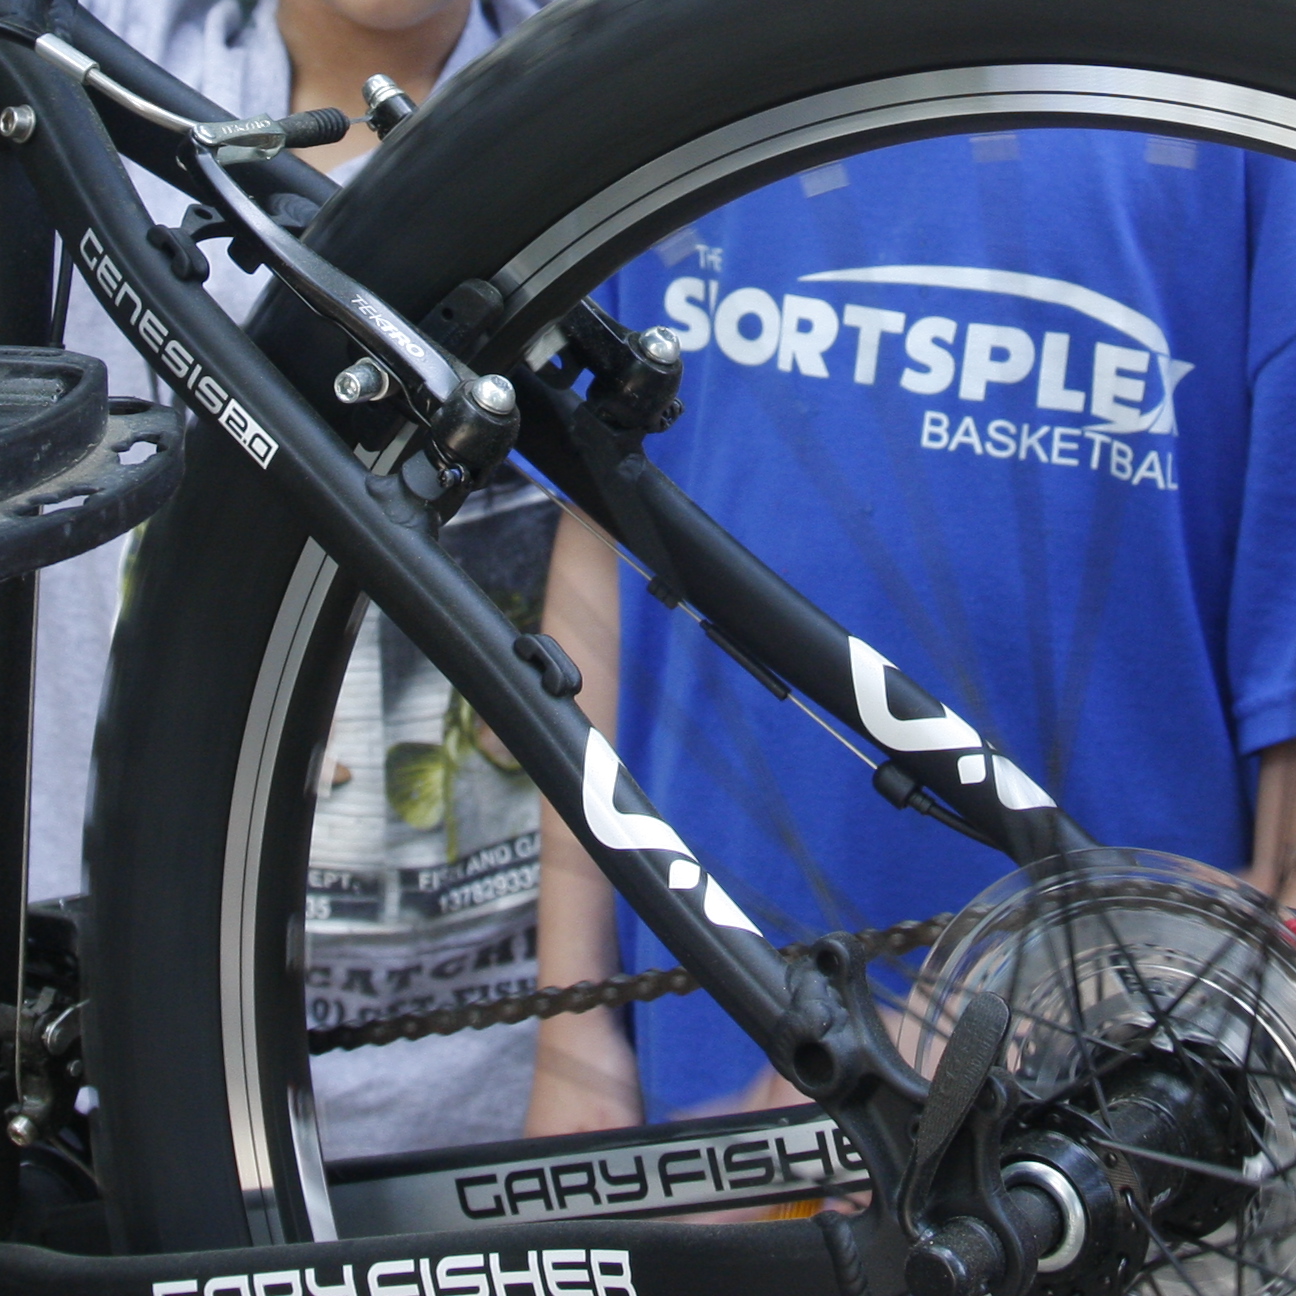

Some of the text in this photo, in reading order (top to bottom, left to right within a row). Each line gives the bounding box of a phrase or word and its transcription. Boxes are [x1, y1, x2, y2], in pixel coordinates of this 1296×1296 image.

[80, 227, 276, 466] GENESIS 2.0
[351, 293, 425, 358] TEKTRO
[920, 410, 1179, 491] BASKETBAL
[454, 1129, 870, 1221] GARY FISHE
[366, 1249, 638, 1296] FISHER
